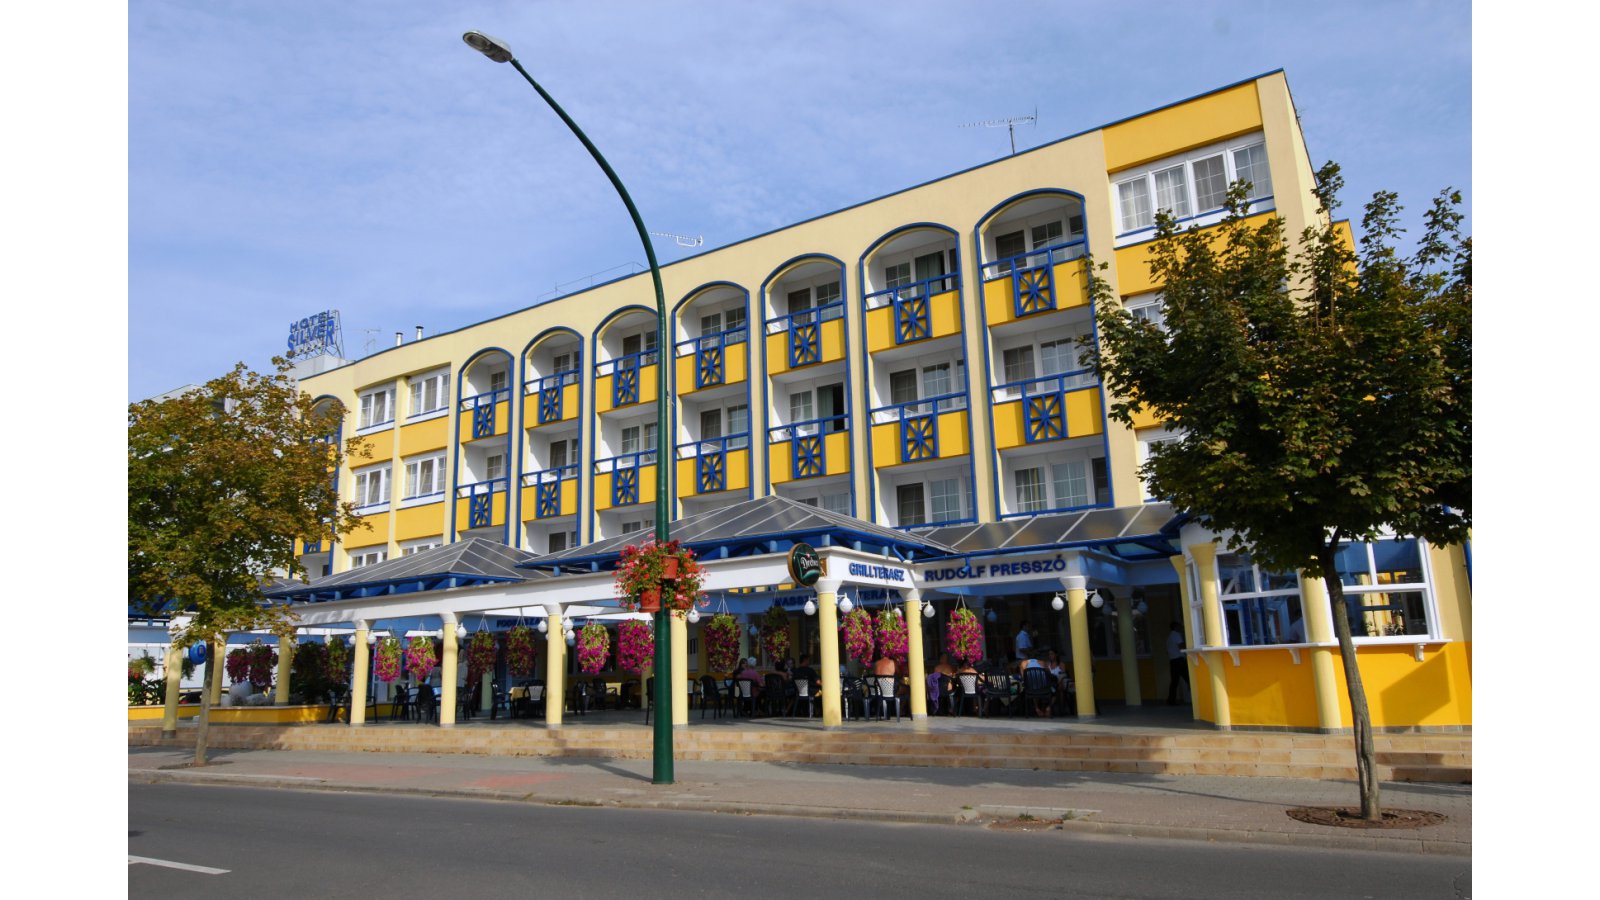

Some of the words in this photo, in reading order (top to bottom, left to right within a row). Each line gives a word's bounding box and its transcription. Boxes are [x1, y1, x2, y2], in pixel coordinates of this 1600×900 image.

[290, 309, 335, 334] HOTEL
[288, 320, 335, 351] SILVER
[848, 562, 905, 582] GRILLTERASZ
[924, 565, 986, 582] RUDOLF
